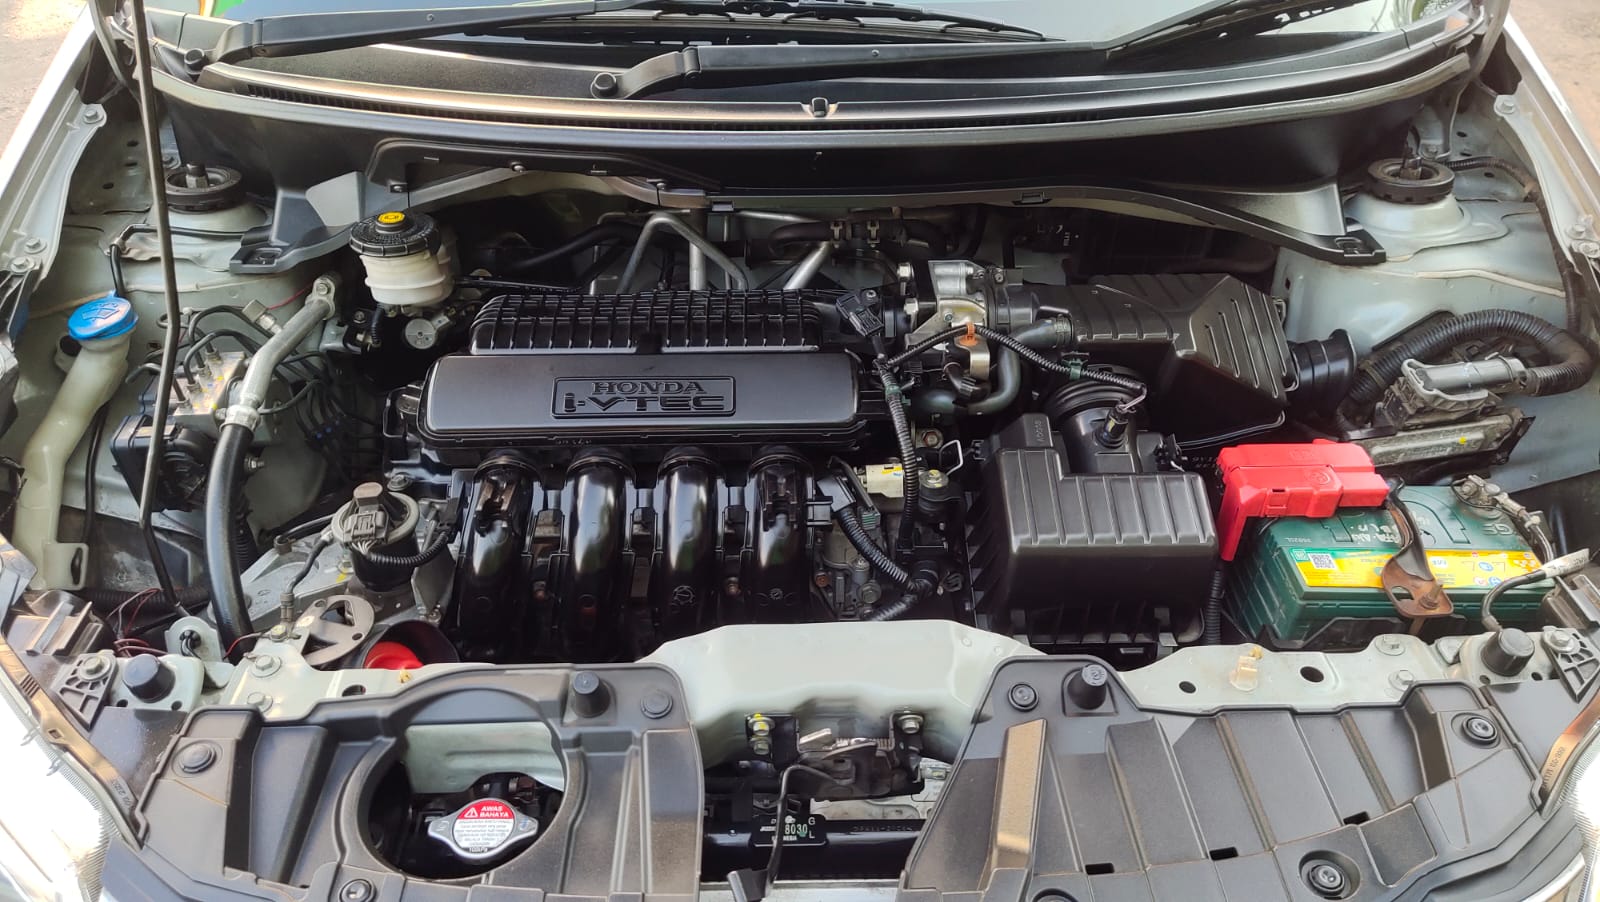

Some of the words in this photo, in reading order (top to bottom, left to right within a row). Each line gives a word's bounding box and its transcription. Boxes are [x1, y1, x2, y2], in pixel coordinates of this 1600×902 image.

[592, 381, 704, 395] HONDA
[564, 392, 725, 412] i-VTEC
[785, 824, 808, 834] 8030
